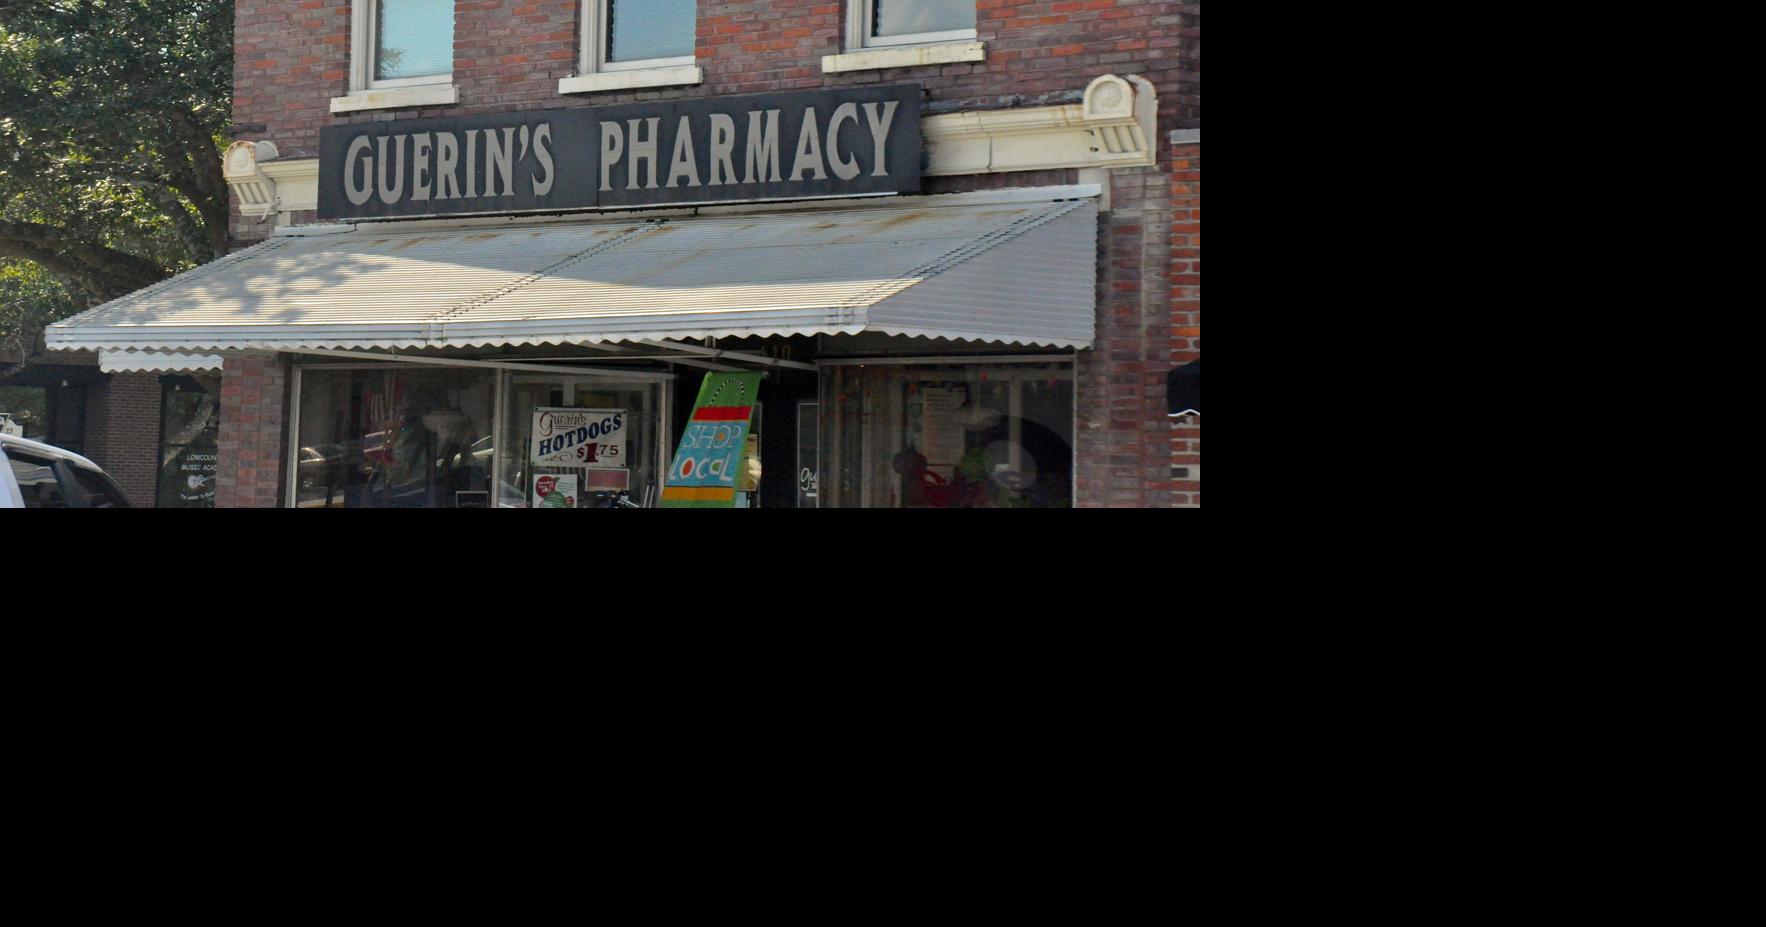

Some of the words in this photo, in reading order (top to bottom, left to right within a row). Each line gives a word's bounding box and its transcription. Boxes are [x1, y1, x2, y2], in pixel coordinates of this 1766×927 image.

[344, 122, 554, 206] GUERIN'S
[599, 101, 899, 192] PHARMACY
[538, 413, 623, 457] HOTDOGS
[682, 425, 743, 449] SHOP
[181, 463, 202, 471] MUSIC
